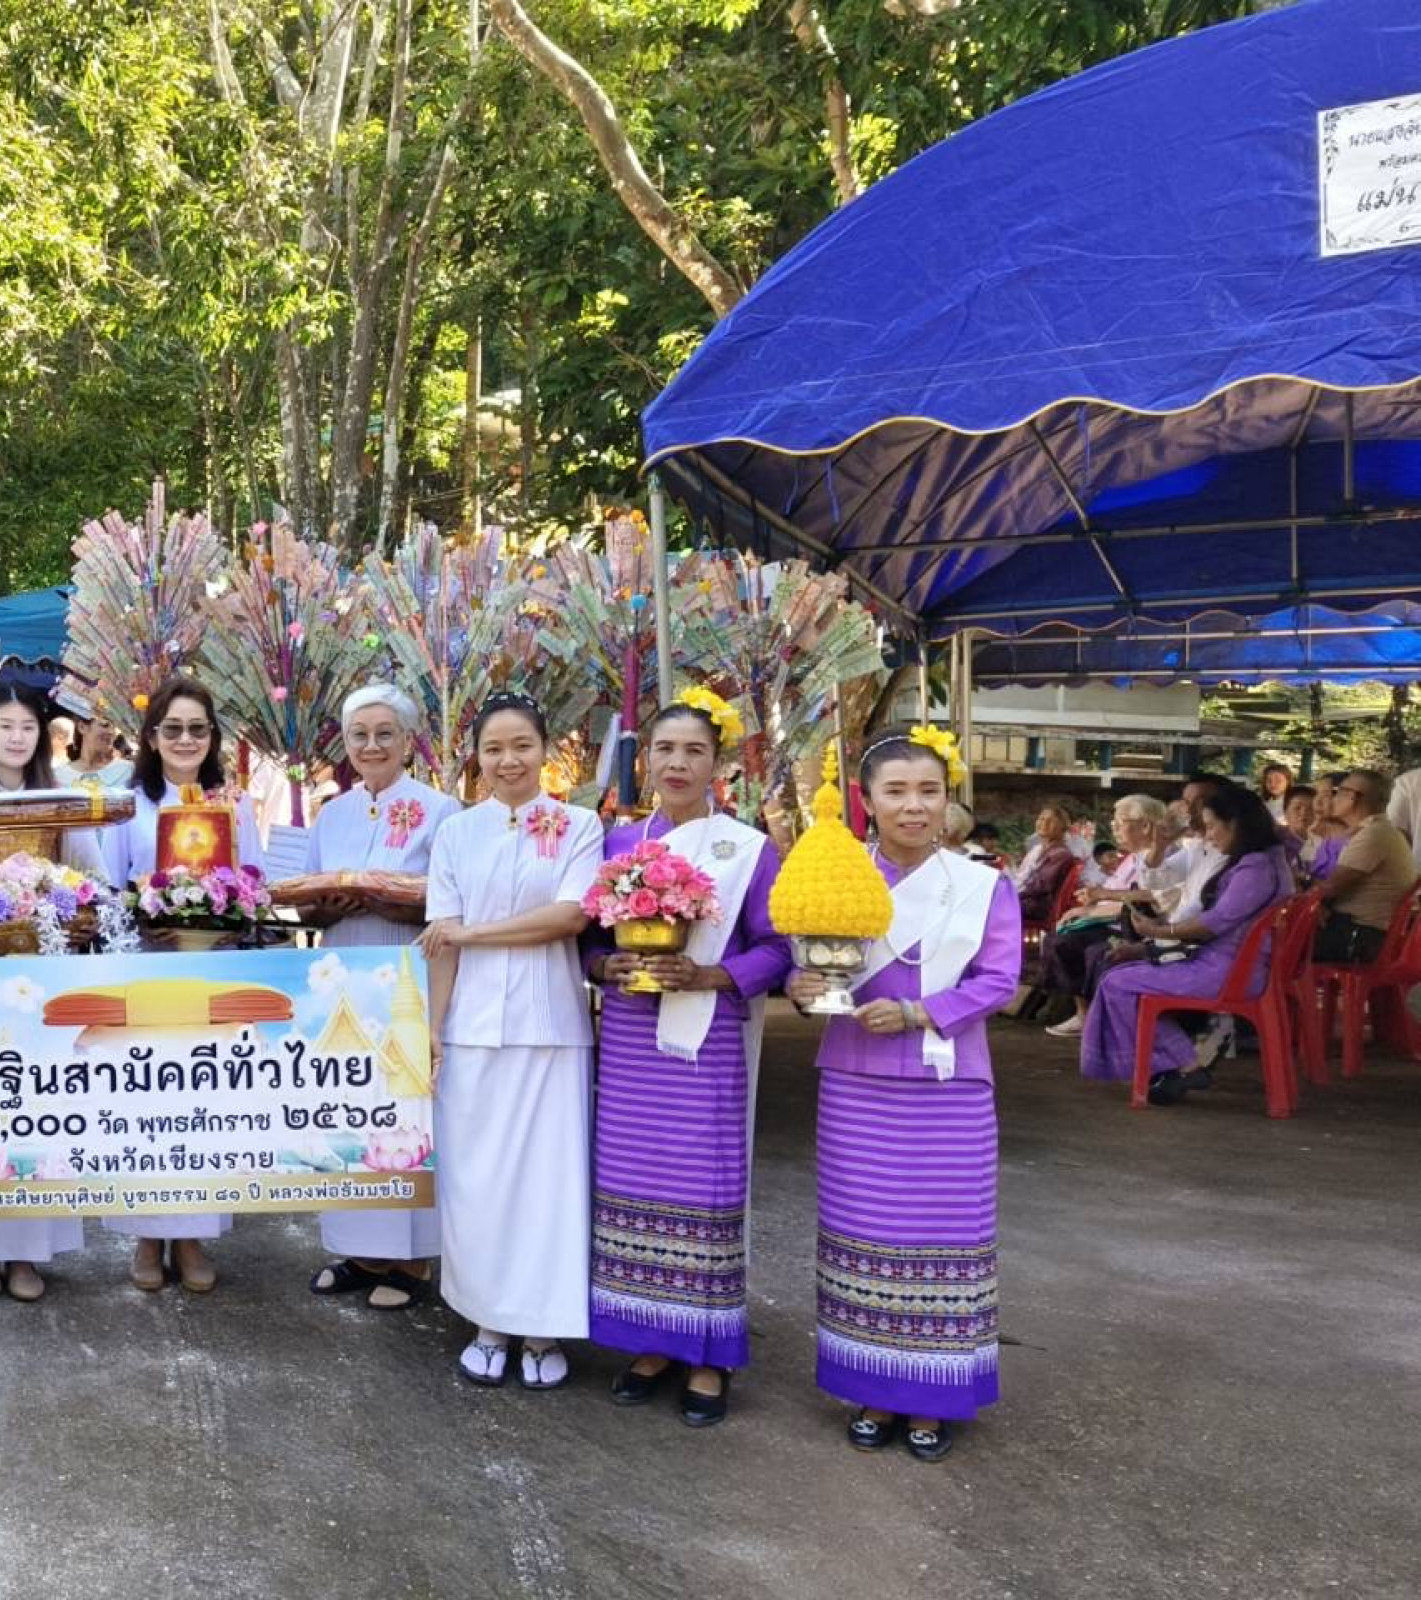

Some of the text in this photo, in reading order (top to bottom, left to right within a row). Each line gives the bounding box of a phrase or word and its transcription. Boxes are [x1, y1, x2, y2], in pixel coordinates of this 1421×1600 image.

[97, 1109, 129, 1135] วัด
[136, 1107, 272, 1143] พุทธศักราช
[281, 1101, 398, 1130] ๒๕๖๘
[68, 1144, 275, 1174] จังหวัดเชียงราย
[247, 1181, 262, 1201] ปี
